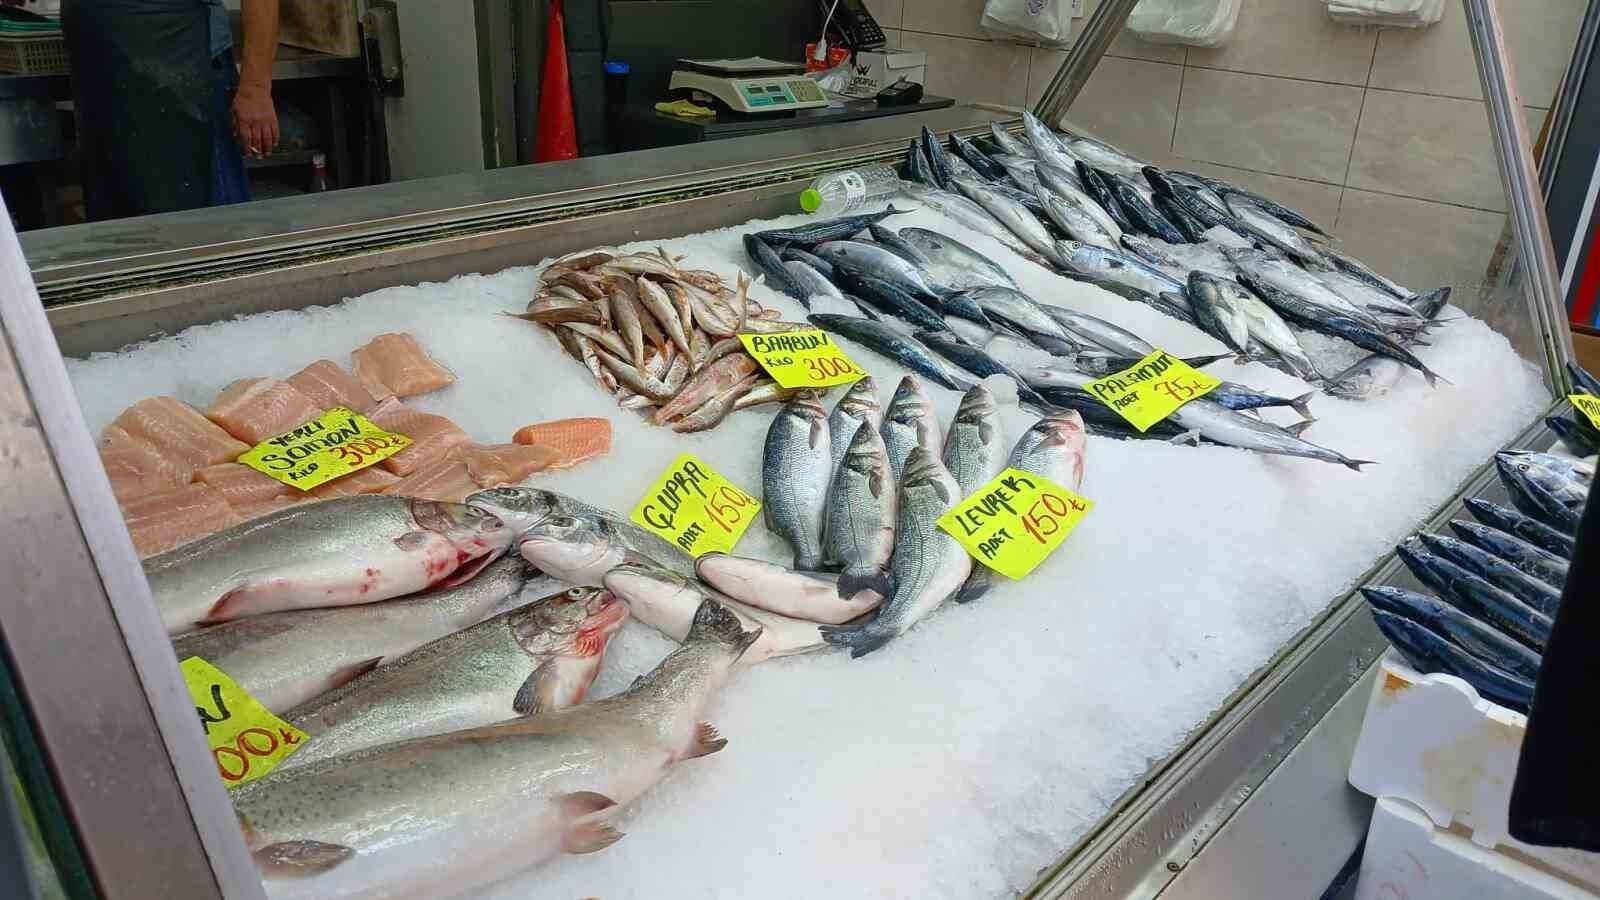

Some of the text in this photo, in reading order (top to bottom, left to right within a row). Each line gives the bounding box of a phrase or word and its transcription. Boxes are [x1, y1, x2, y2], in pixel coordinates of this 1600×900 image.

[752, 333, 828, 353] BARBUN
[1092, 352, 1174, 401] PALAMUT
[261, 418, 361, 470] SOMON
[954, 475, 1036, 537] LEVREK
[676, 521, 706, 553] ADET
[977, 527, 1015, 560] ADET
